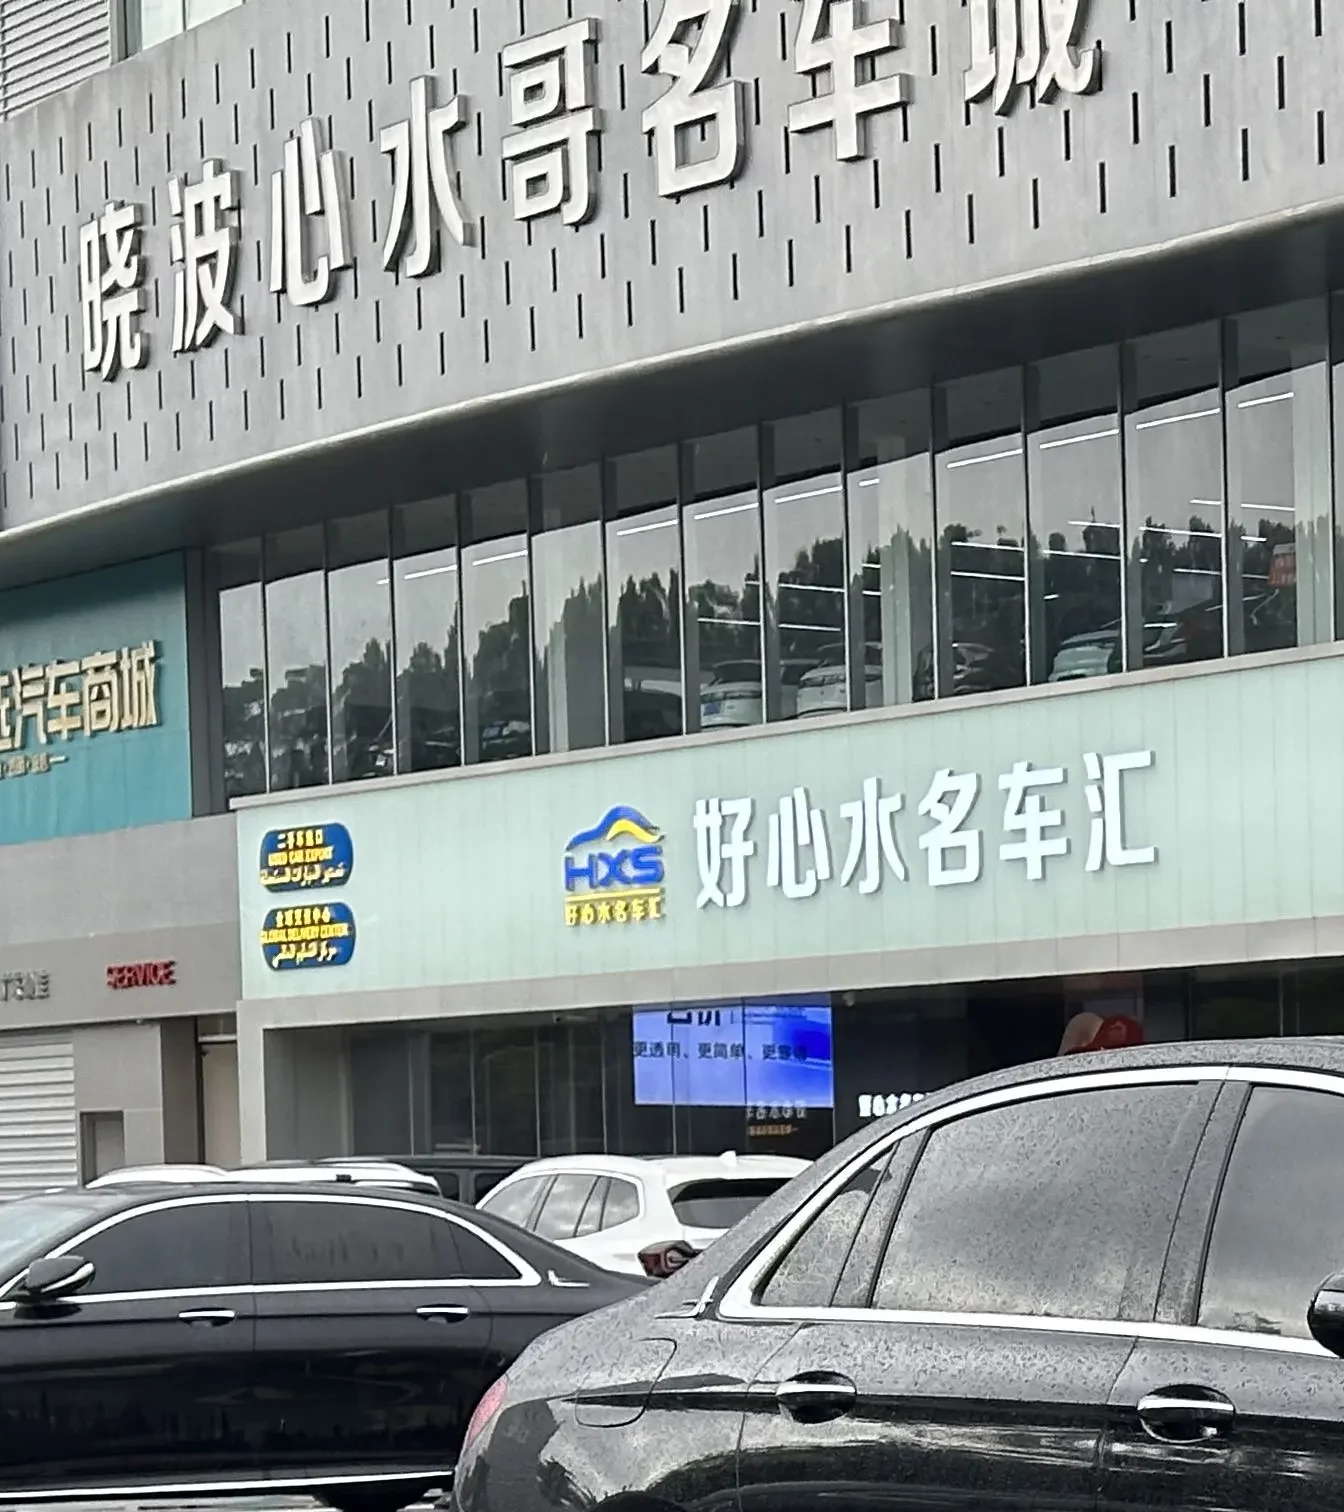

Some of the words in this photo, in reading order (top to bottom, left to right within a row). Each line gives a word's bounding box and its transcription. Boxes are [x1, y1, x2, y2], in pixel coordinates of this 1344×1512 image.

[693, 749, 1159, 910] 好心水名车汇
[565, 845, 665, 892] HXS
[107, 960, 176, 990] SERVICE
